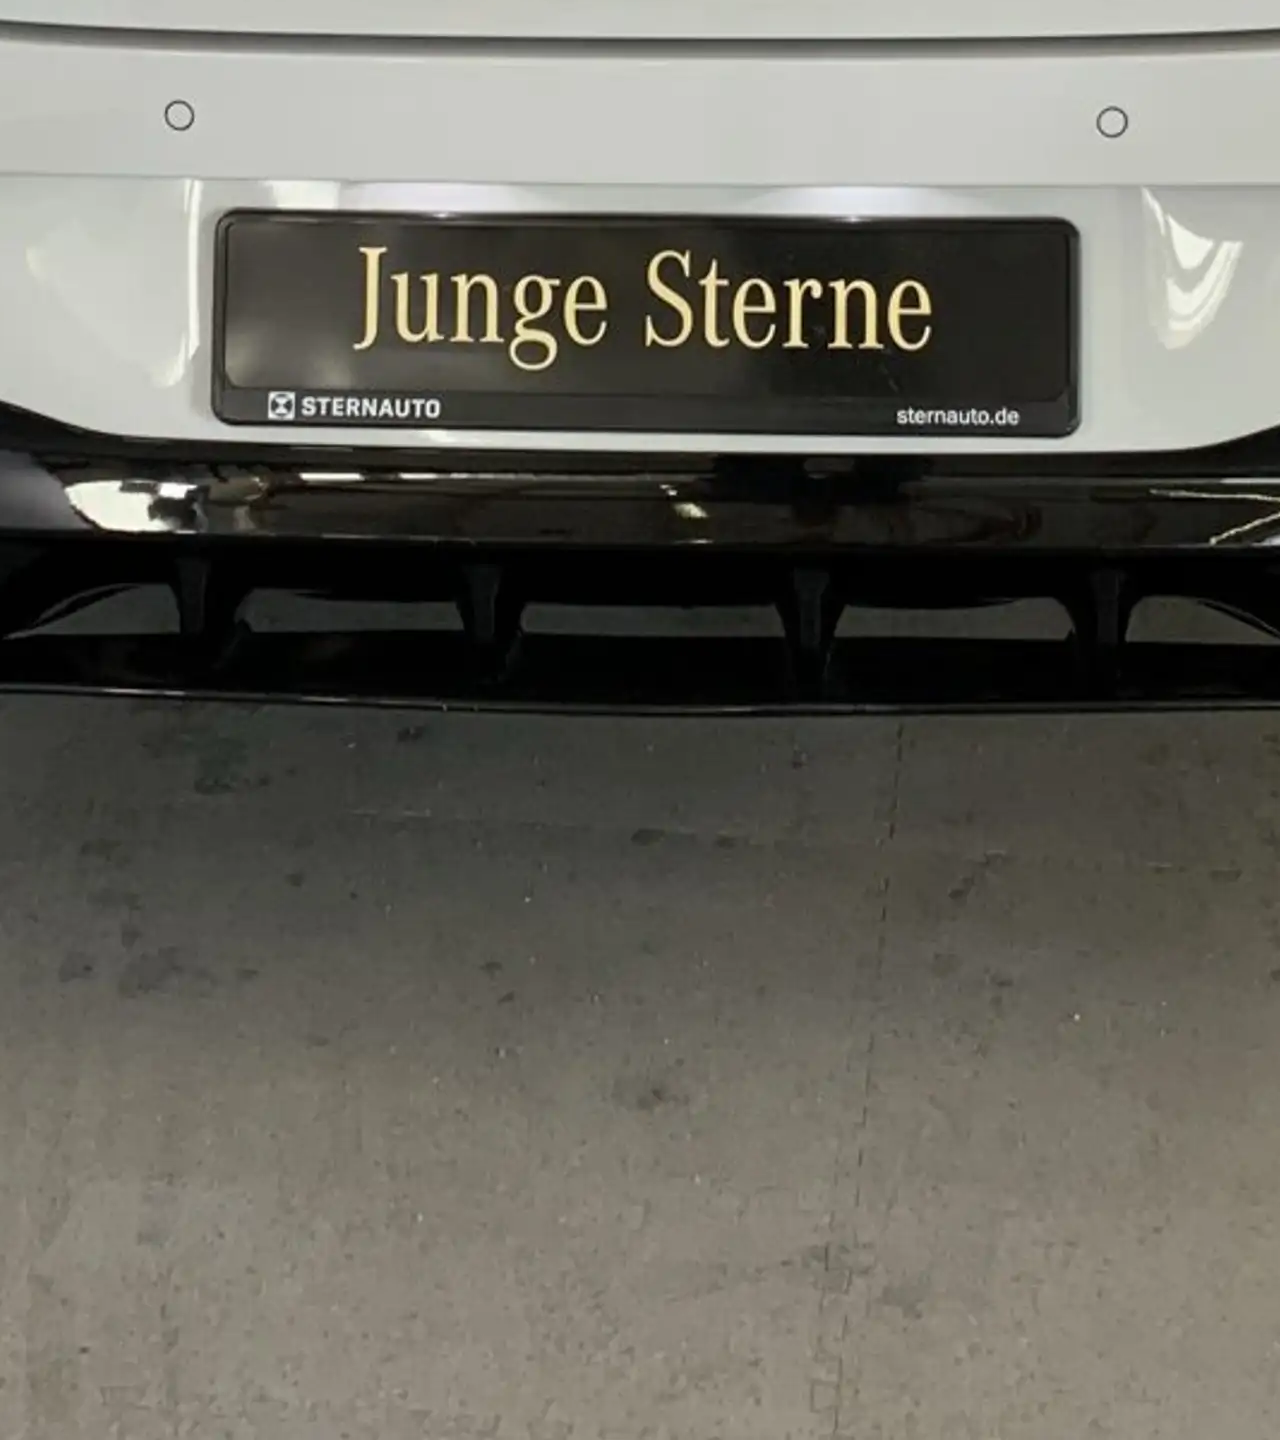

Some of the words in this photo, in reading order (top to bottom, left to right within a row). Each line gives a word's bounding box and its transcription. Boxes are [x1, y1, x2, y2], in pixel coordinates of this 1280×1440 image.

[354, 246, 608, 370] Junge
[645, 250, 933, 351] Sterne
[302, 396, 441, 418] STERNAUTO
[897, 406, 1019, 425] sternauto.de
